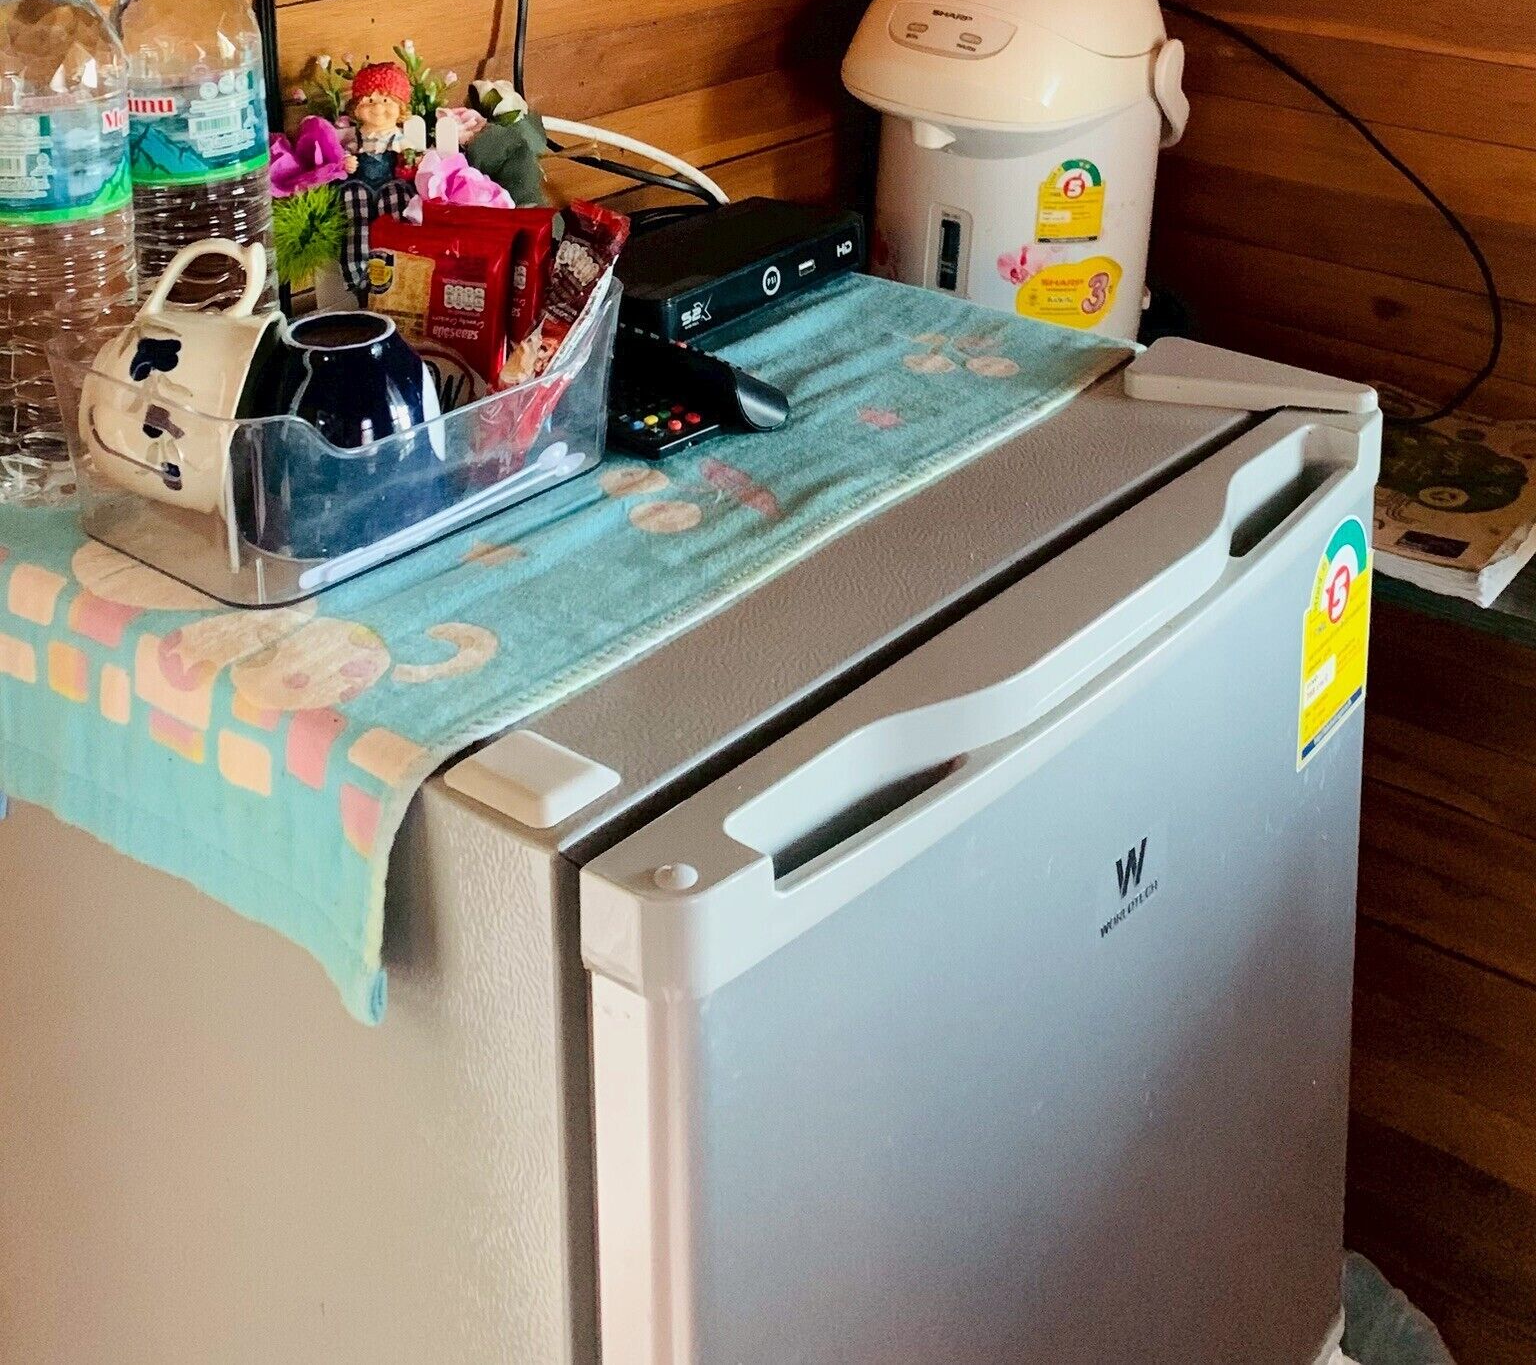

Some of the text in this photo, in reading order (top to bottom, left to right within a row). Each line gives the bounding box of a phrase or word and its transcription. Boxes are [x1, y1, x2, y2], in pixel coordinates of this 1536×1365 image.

[931, 9, 973, 22] SHARP
[836, 240, 853, 257] HD
[1081, 272, 1110, 314] 3
[1115, 837, 1148, 900] W
